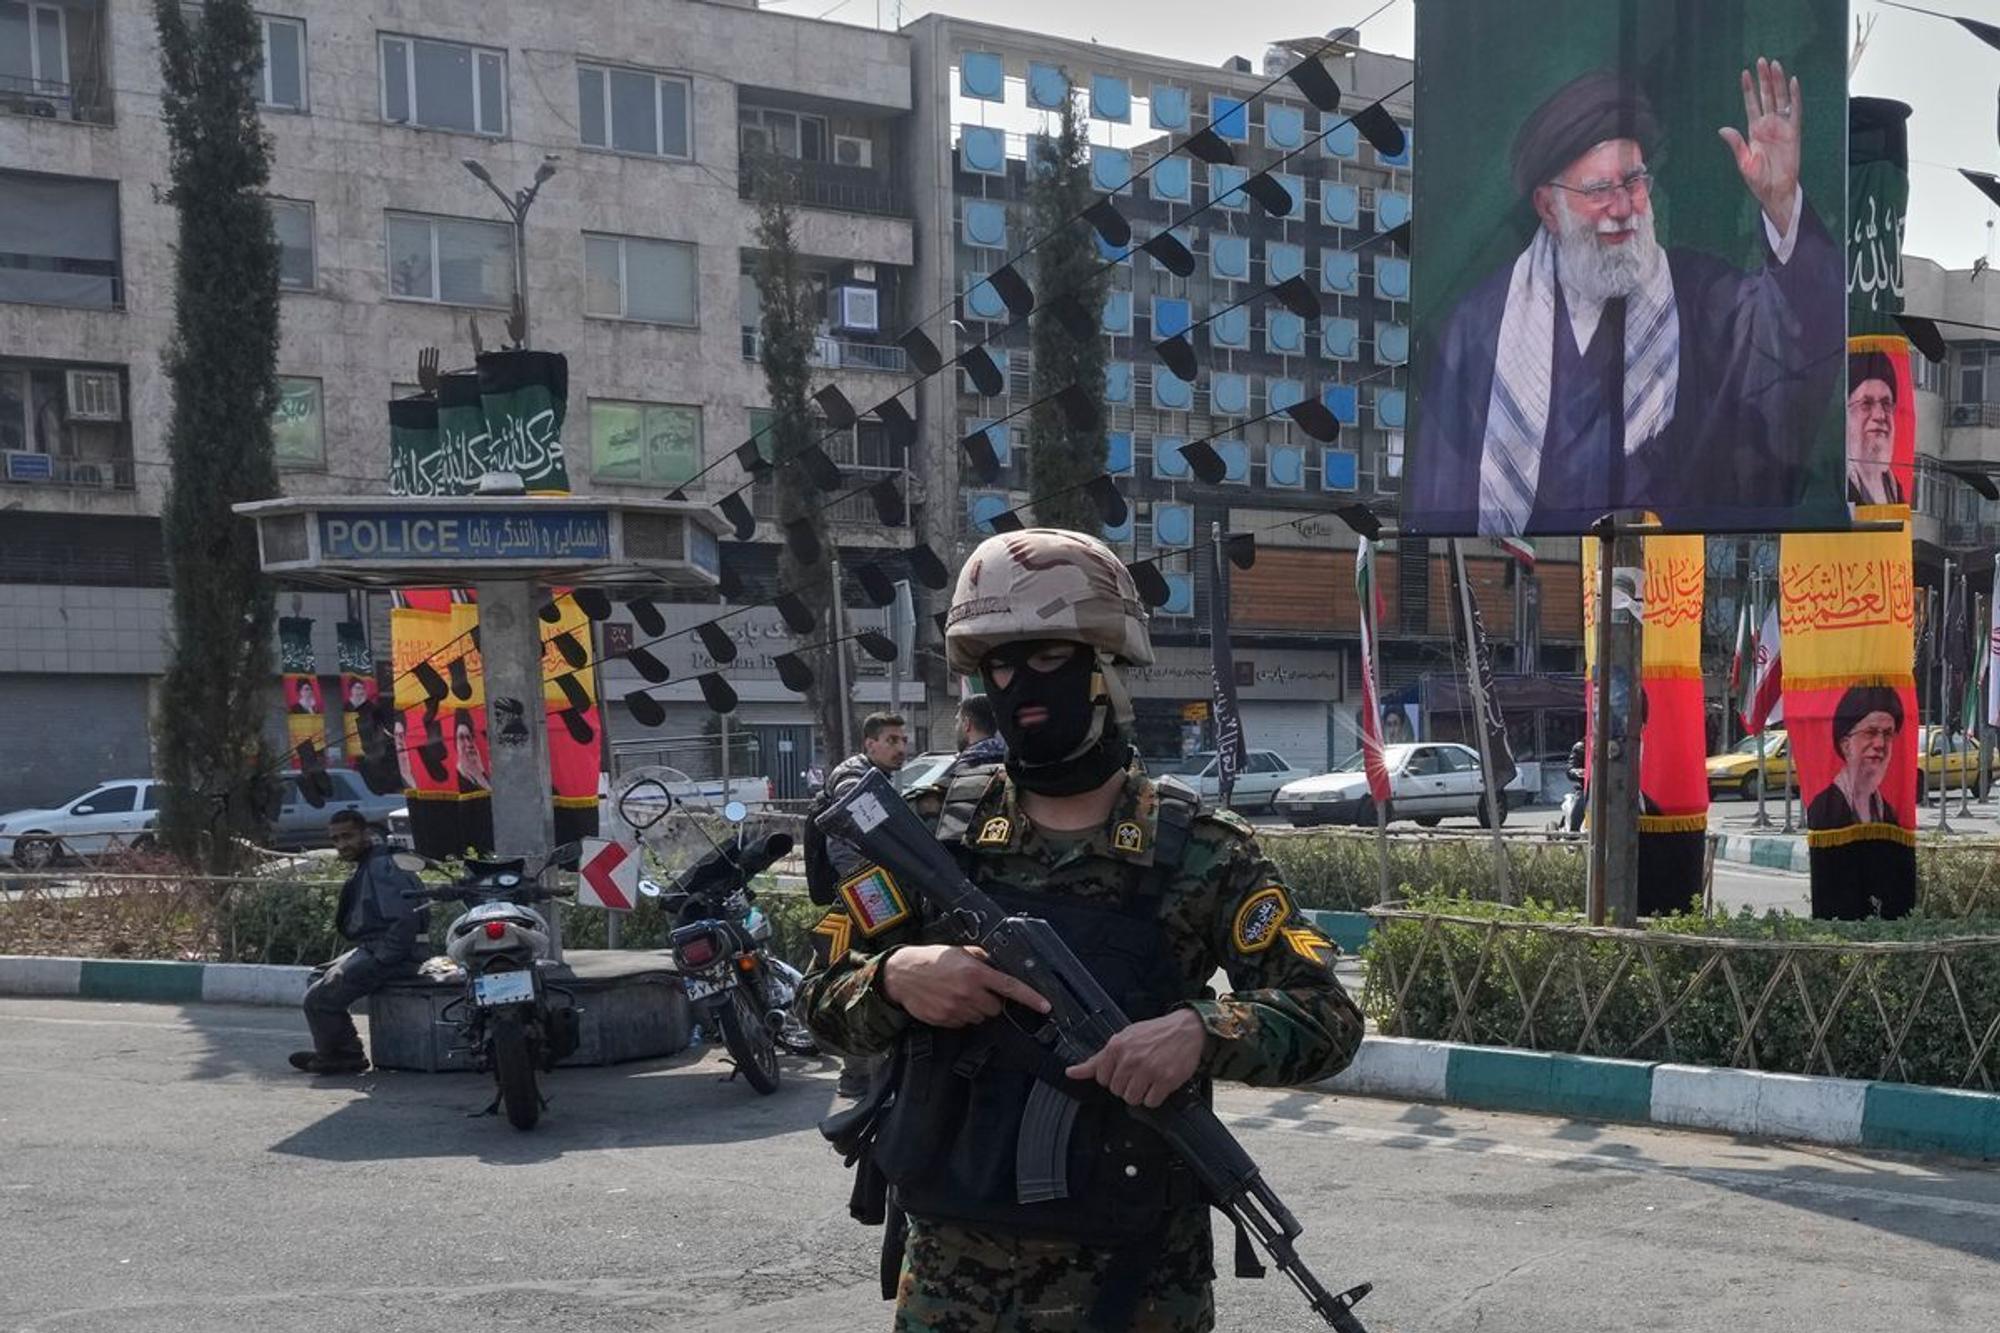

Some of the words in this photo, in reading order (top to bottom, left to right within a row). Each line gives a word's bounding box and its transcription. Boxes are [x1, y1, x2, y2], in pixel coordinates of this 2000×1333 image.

[327, 519, 459, 553] POLICE
[467, 518, 491, 554] ناجا
[495, 518, 540, 555] رانندگی
[554, 518, 608, 555] راهنمایی
